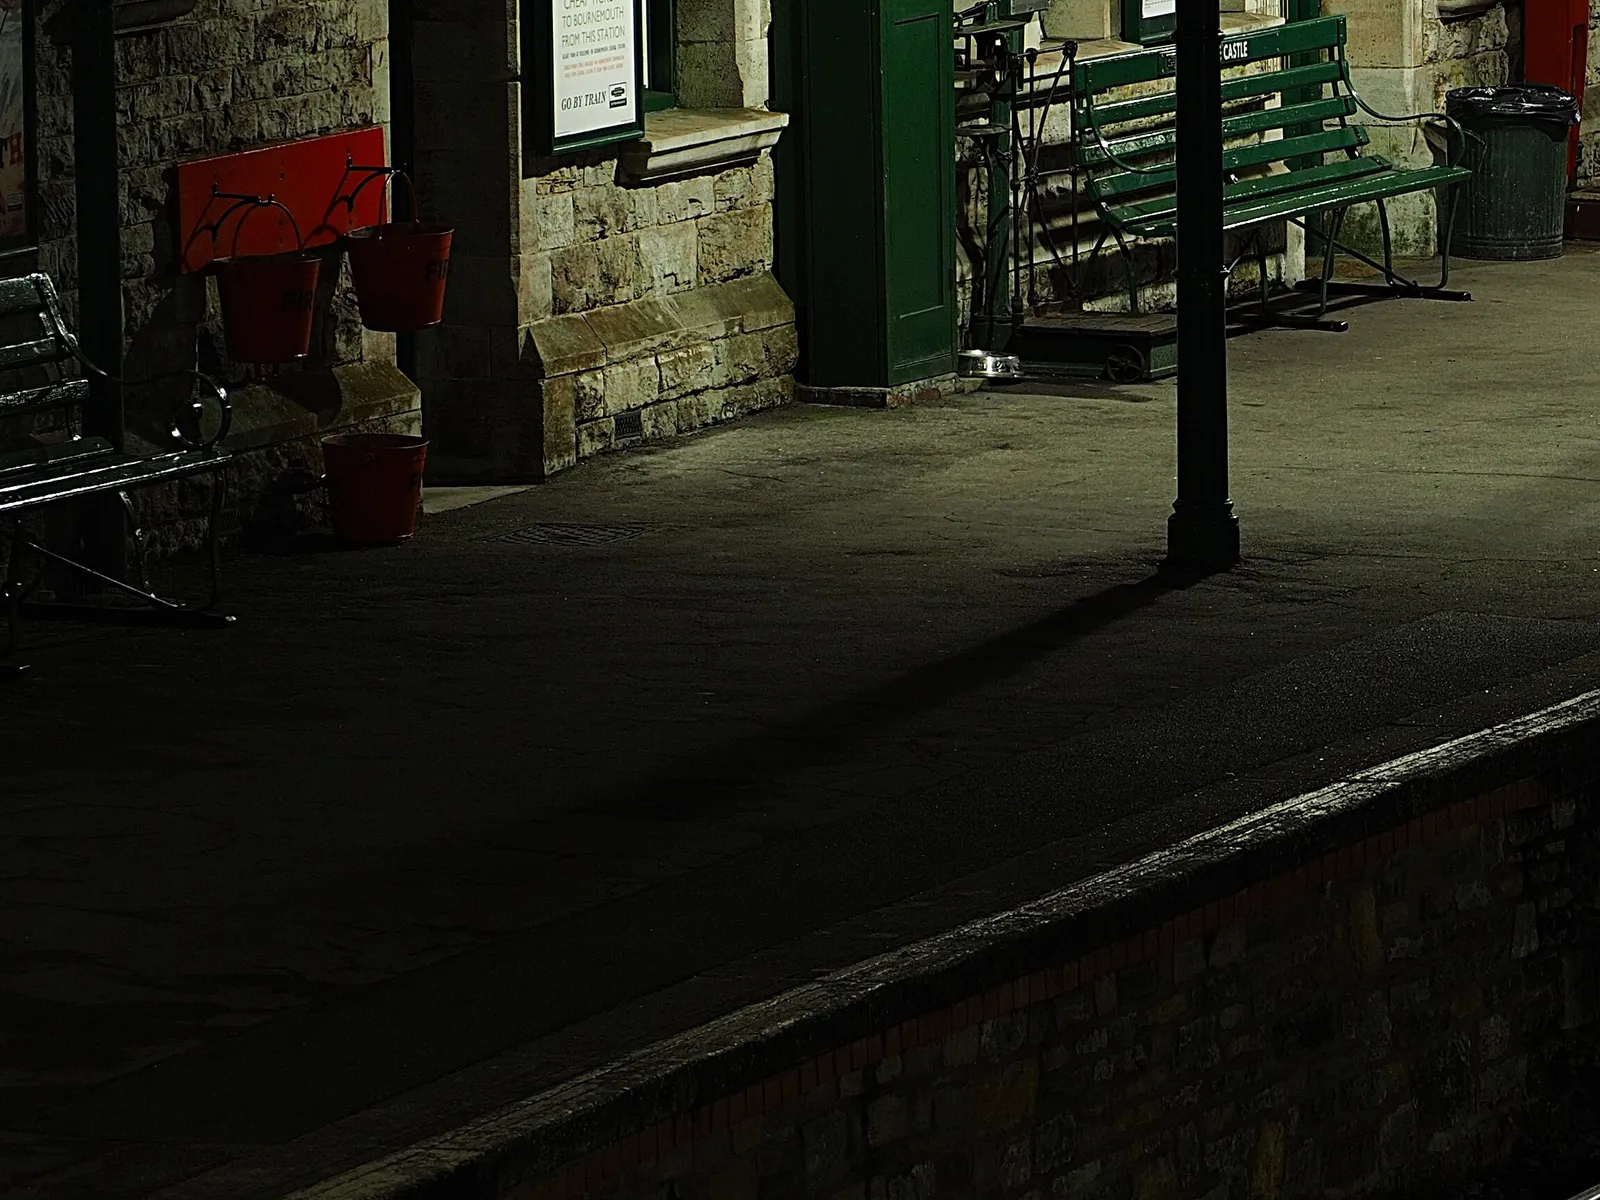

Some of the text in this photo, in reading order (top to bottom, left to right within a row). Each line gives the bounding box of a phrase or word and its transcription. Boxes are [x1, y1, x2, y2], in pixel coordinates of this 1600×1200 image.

[562, 6, 625, 28] TO BOURNEMOUTH
[562, 25, 626, 49] FROM THIS STATION
[1223, 41, 1248, 60] CASTLE
[561, 97, 573, 111] GO
[573, 95, 584, 109] BY
[584, 91, 607, 108] TRAIN
